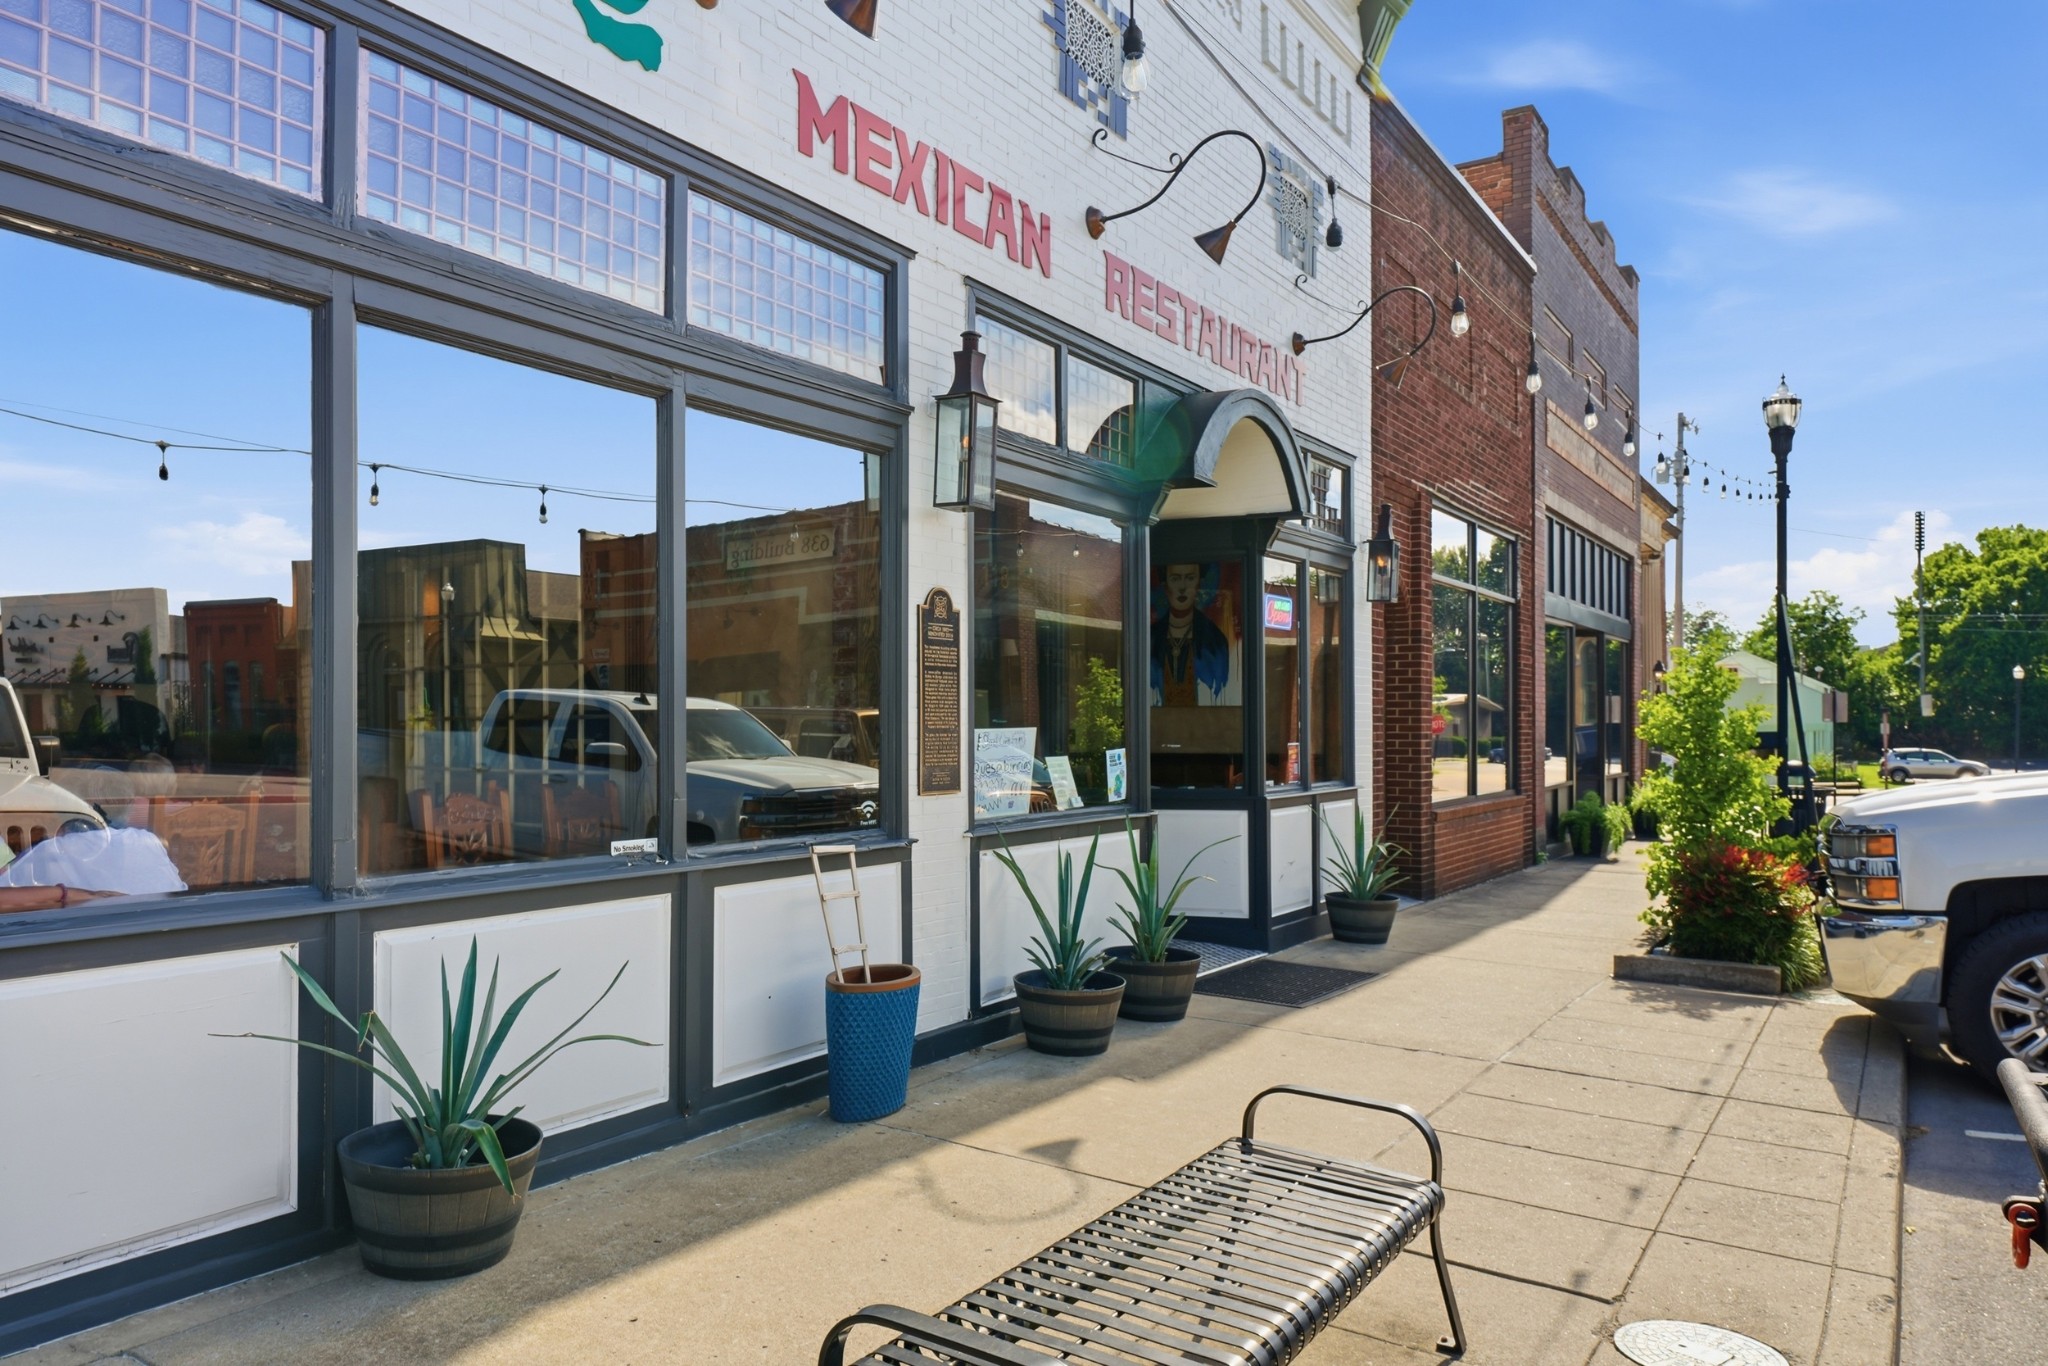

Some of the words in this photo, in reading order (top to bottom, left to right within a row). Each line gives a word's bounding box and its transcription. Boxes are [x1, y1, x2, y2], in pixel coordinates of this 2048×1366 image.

[792, 68, 1051, 278] MEXICAN
[1103, 250, 1307, 406] RESTAURANT
[622, 844, 645, 852] Smoking
